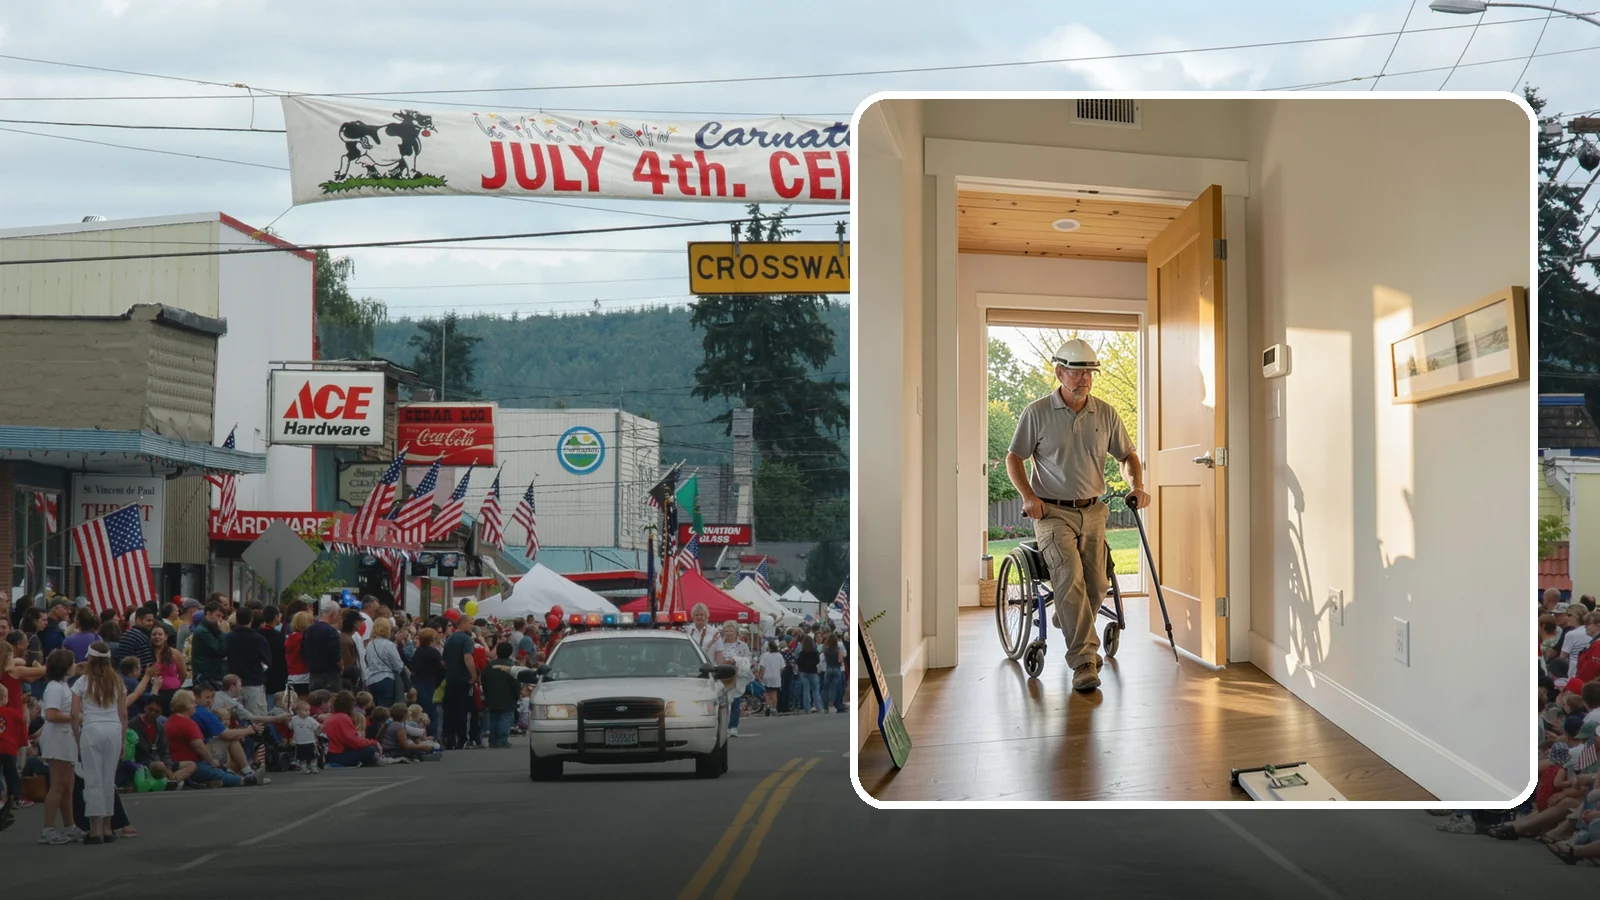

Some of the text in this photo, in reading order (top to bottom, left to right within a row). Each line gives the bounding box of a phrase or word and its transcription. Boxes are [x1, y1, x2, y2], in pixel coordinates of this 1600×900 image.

[481, 141, 604, 193] JULY
[632, 149, 747, 198] 4th.
[697, 254, 850, 280] CROSSWA
[282, 380, 373, 420] ACE
[405, 409, 486, 422] CEDAR LOG
[283, 420, 371, 436] Hardware
[416, 428, 477, 447] Coca-Cola
[353, 467, 385, 479] Simpl
[95, 485, 124, 494] Vincent
[126, 485, 136, 495] de
[137, 486, 155, 496] Paul
[81, 503, 154, 522] THT
[212, 516, 331, 536] HARDARE
[688, 526, 741, 535] CRNATION
[698, 535, 730, 543] GLASS
